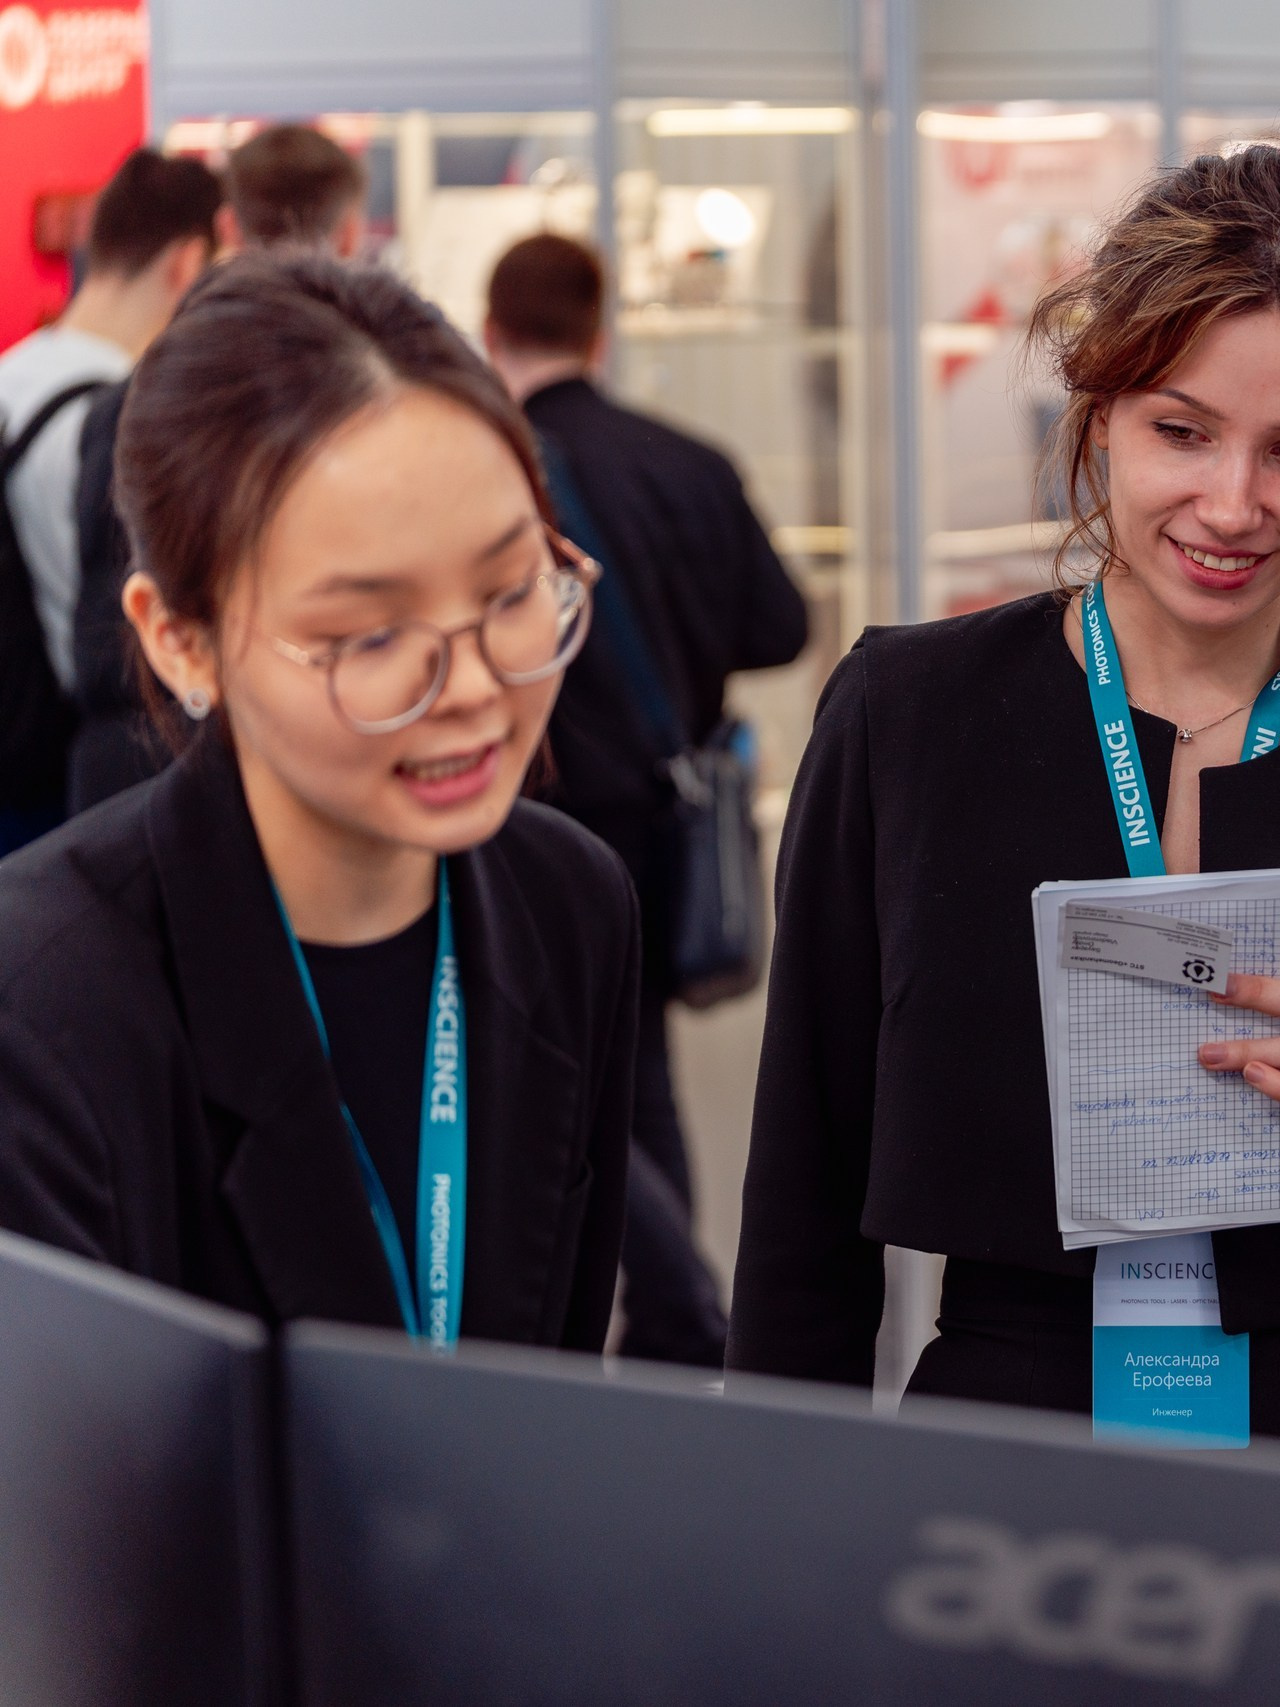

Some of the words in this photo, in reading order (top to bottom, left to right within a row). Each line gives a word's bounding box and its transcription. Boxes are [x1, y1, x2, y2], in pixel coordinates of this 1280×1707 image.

[1086, 579, 1096, 611] TOO
[1087, 609, 1111, 685] PHOTONICS
[1103, 719, 1151, 847] INSCIENCE
[431, 956, 460, 1123] INSCIENCE
[429, 1173, 451, 1292] PHOTONICS
[1121, 1262, 1215, 1280] INSCIENC
[1124, 1352, 1220, 1370] Александра
[1133, 1372, 1212, 1390] Ерофеева
[1152, 1407, 1193, 1418] Инженер
